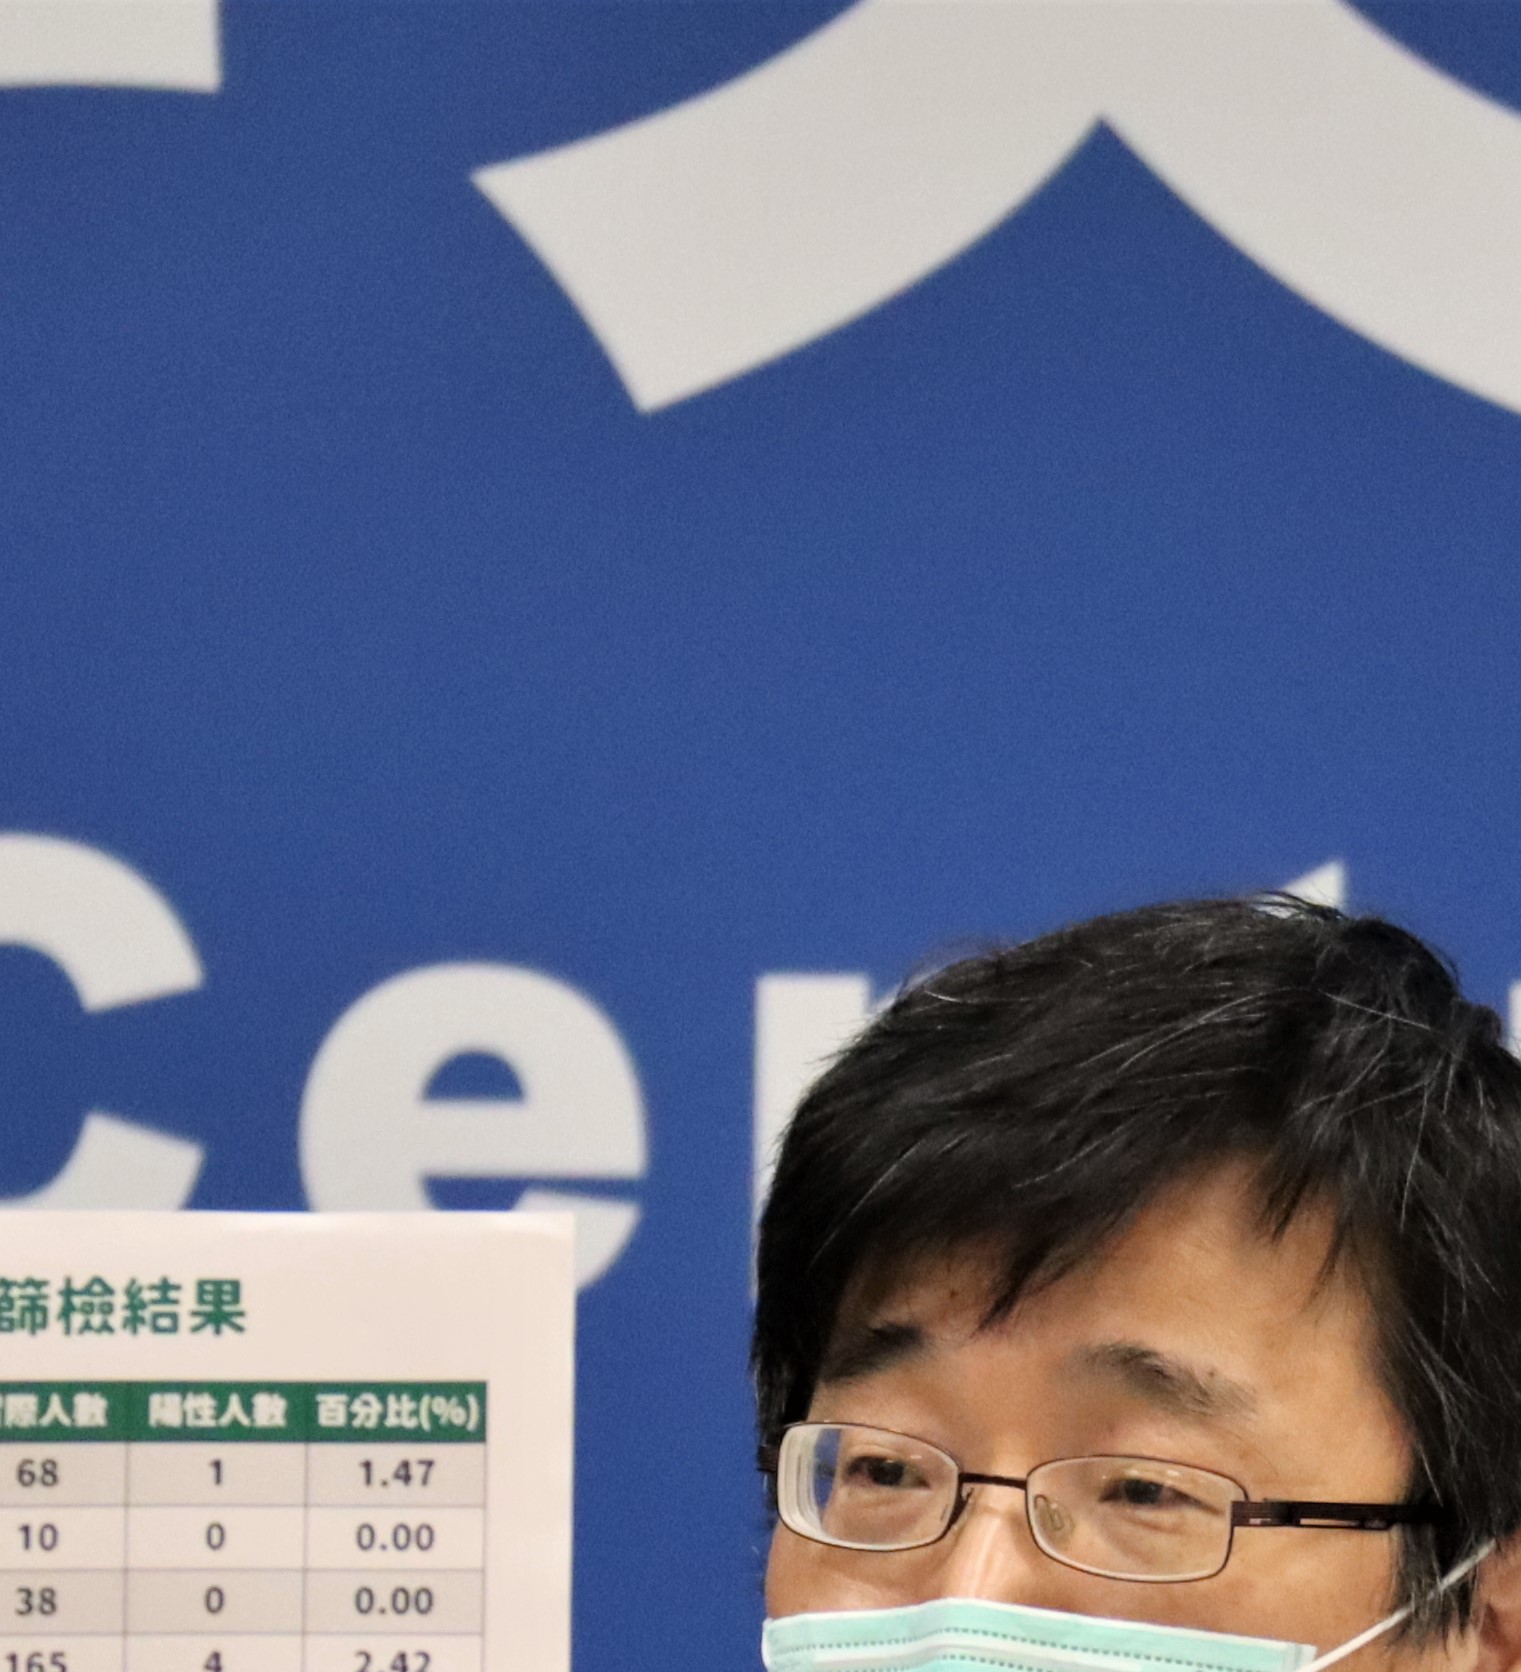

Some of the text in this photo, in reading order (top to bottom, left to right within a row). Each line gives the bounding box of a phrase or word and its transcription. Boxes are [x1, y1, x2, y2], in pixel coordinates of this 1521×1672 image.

[149, 1392, 287, 1427] 陽性人數
[316, 1393, 479, 1431] 百分比(%)
[16, 1458, 60, 1488] 68
[360, 1459, 435, 1487] 1.47
[18, 1522, 59, 1553] 10
[355, 1522, 436, 1552] 0.00
[15, 1586, 58, 1617] 38
[354, 1585, 435, 1616] 0.00
